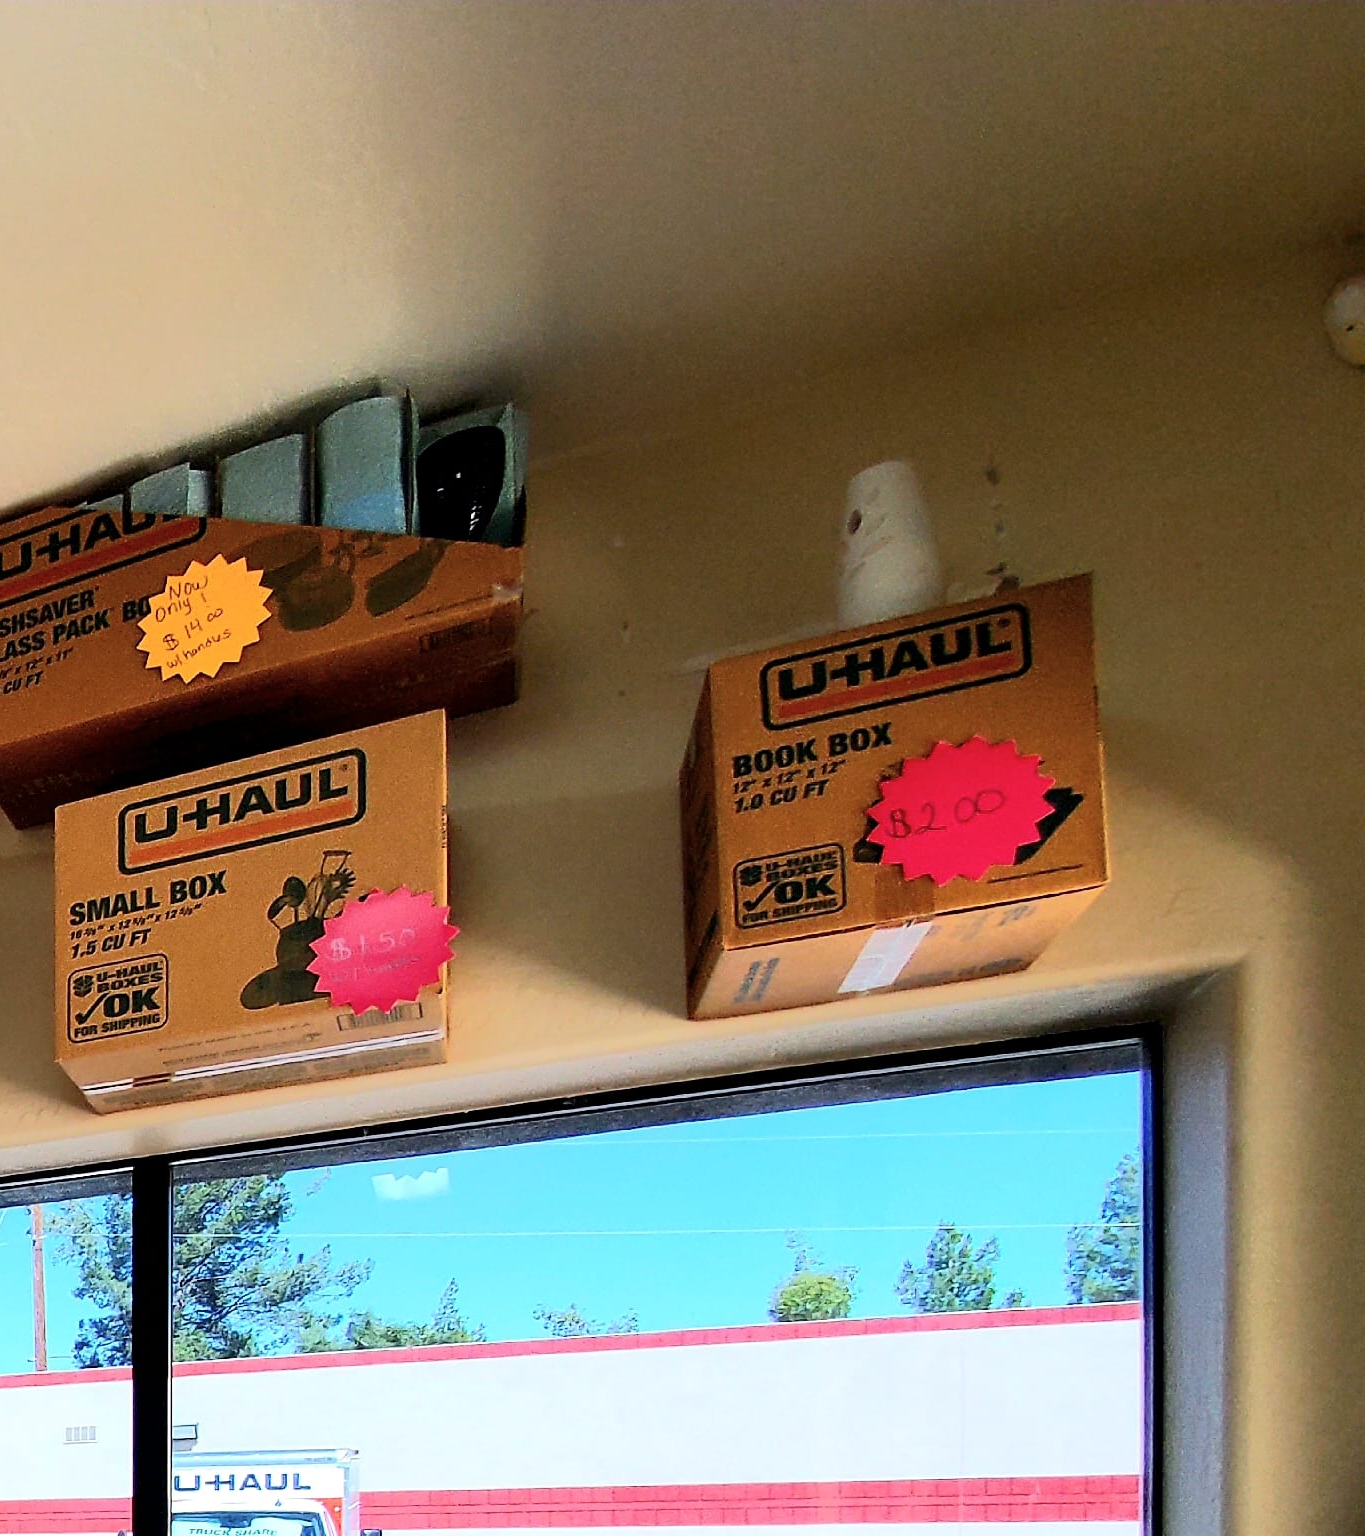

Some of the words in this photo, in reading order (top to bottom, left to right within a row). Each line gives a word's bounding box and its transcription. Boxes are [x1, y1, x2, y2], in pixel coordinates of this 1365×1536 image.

[53, 609, 111, 645] PACK
[778, 622, 1013, 701] U-HAUL
[3, 677, 19, 691] CU
[26, 672, 43, 688] FT
[732, 736, 818, 779] BOOK
[829, 722, 894, 758] BOX
[134, 766, 349, 843] U-HAUL
[734, 791, 765, 814] 1.0
[769, 784, 798, 807] CU
[802, 779, 830, 801] FT
[69, 887, 161, 926] SMALL
[169, 870, 227, 905] BOX
[773, 873, 835, 904] OK
[742, 909, 769, 924] FOR
[102, 933, 123, 953] CU
[125, 928, 151, 948] FT
[103, 987, 161, 1018] OK
[74, 1024, 98, 1039] FOR
[101, 1013, 161, 1035] SHIPPING
[174, 1473, 312, 1491] U-HAUL
[189, 1528, 231, 1536] TRUCK
[235, 1528, 278, 1536] SHARE
